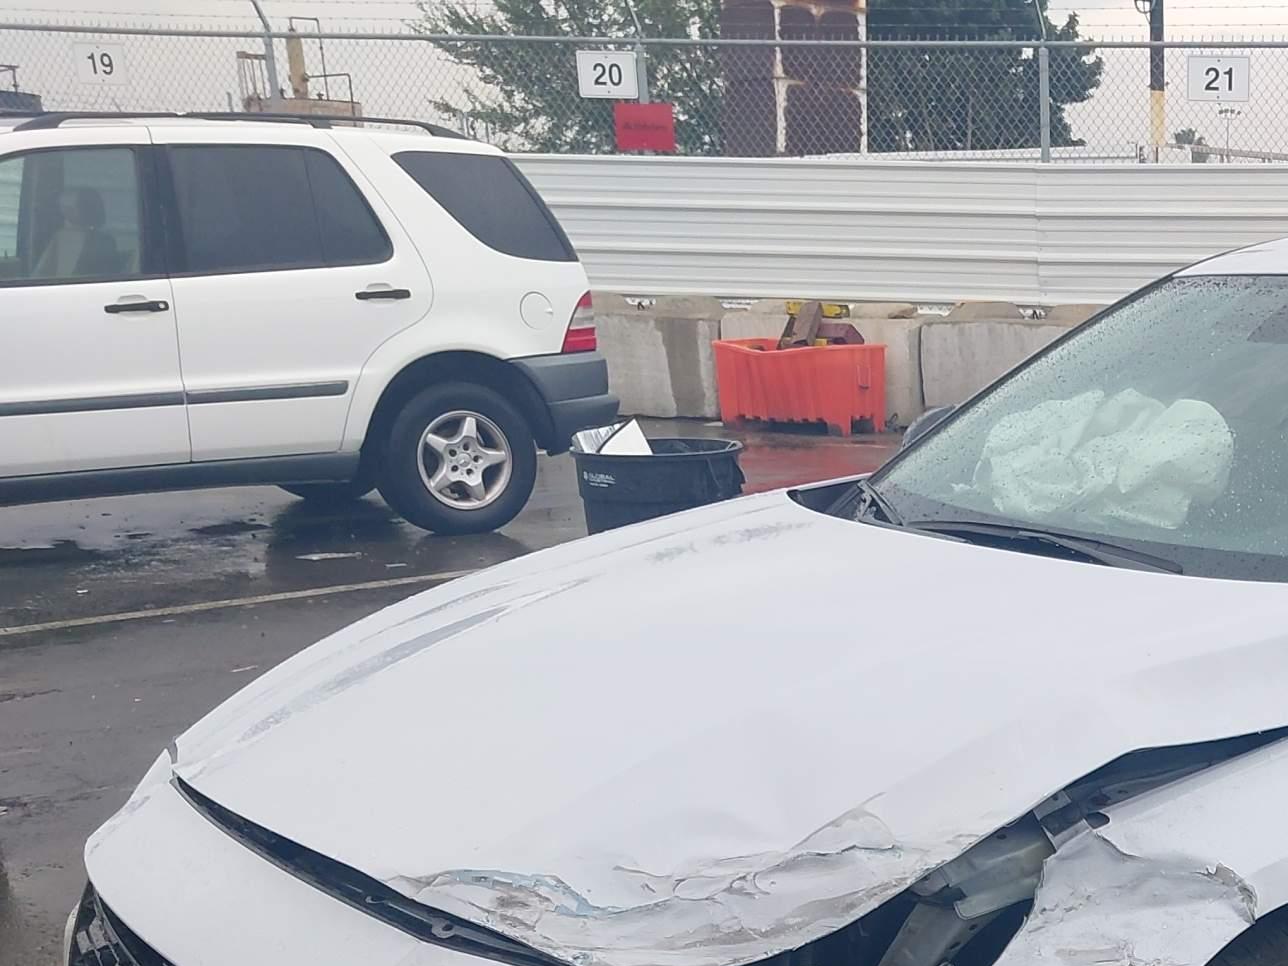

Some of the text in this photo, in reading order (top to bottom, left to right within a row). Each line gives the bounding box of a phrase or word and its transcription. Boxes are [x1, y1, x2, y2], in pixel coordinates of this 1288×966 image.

[87, 52, 114, 76] 19
[592, 62, 623, 87] 20
[1204, 67, 1233, 91] 21
